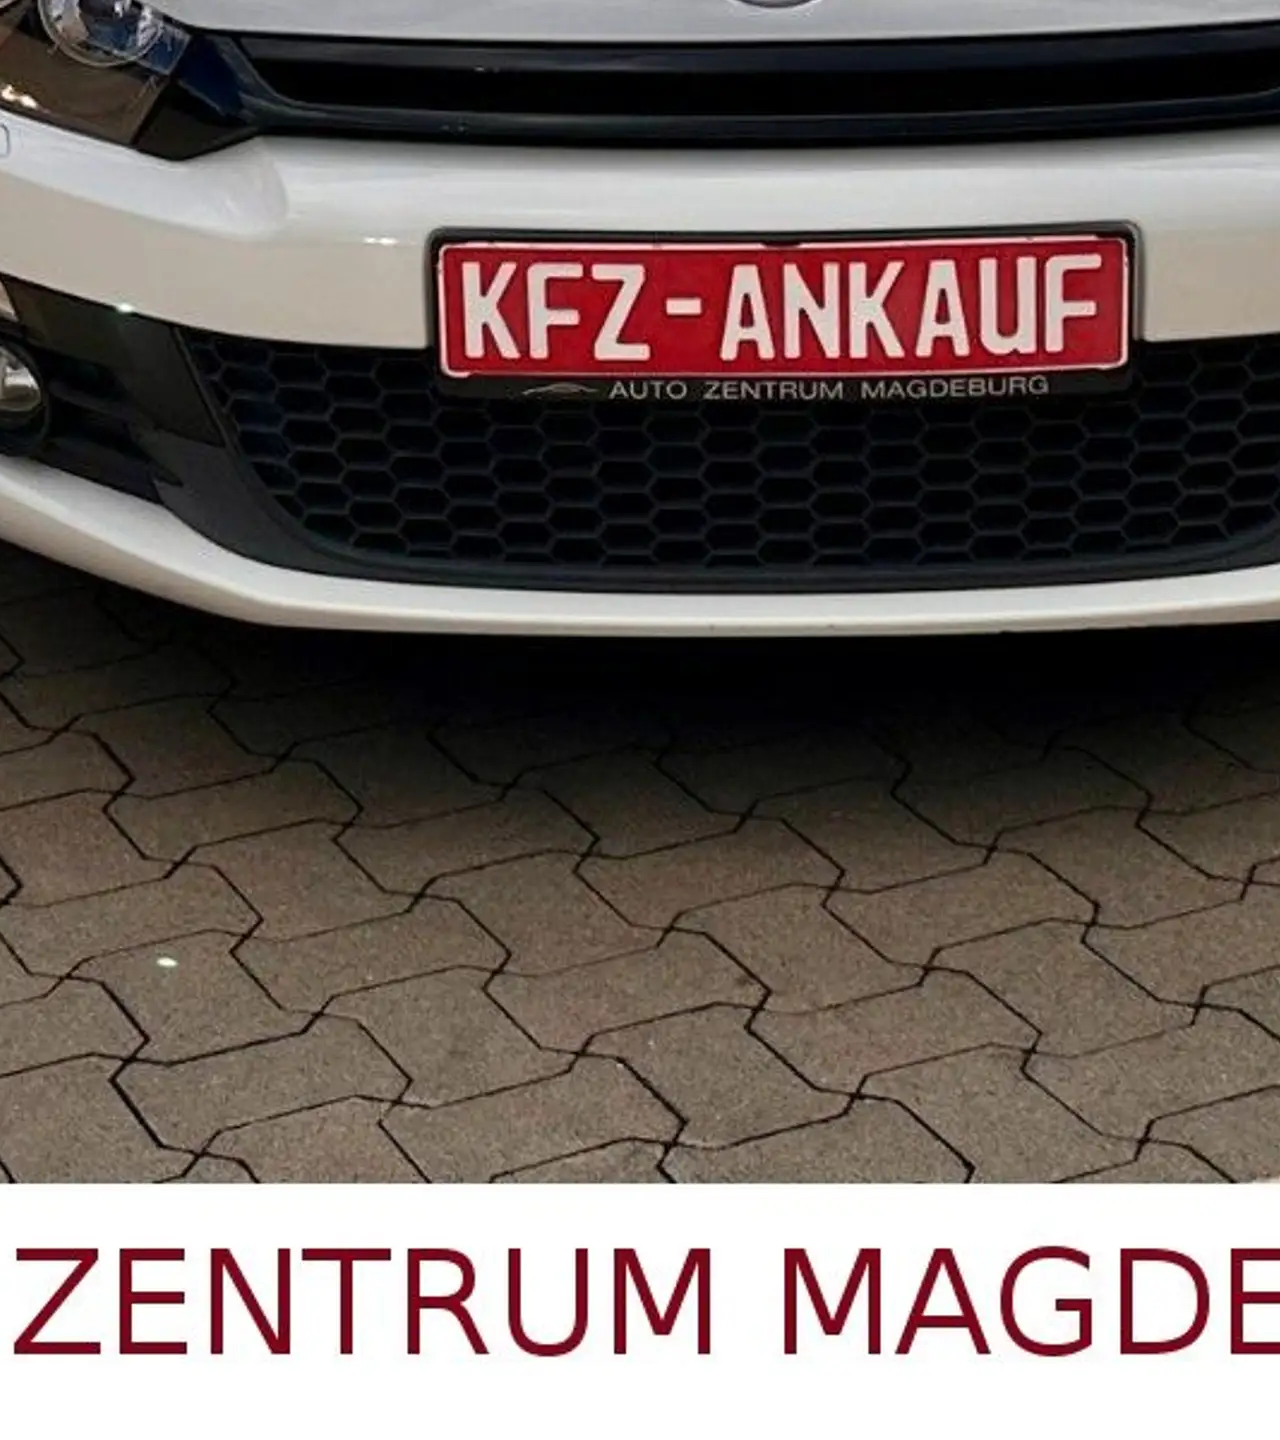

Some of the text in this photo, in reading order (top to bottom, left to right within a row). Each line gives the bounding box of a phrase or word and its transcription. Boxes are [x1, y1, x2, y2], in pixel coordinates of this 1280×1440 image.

[461, 254, 1103, 361] KFZ-ANKAUF
[608, 375, 1049, 400] AUTO ZENTRUM MAGDEBURG
